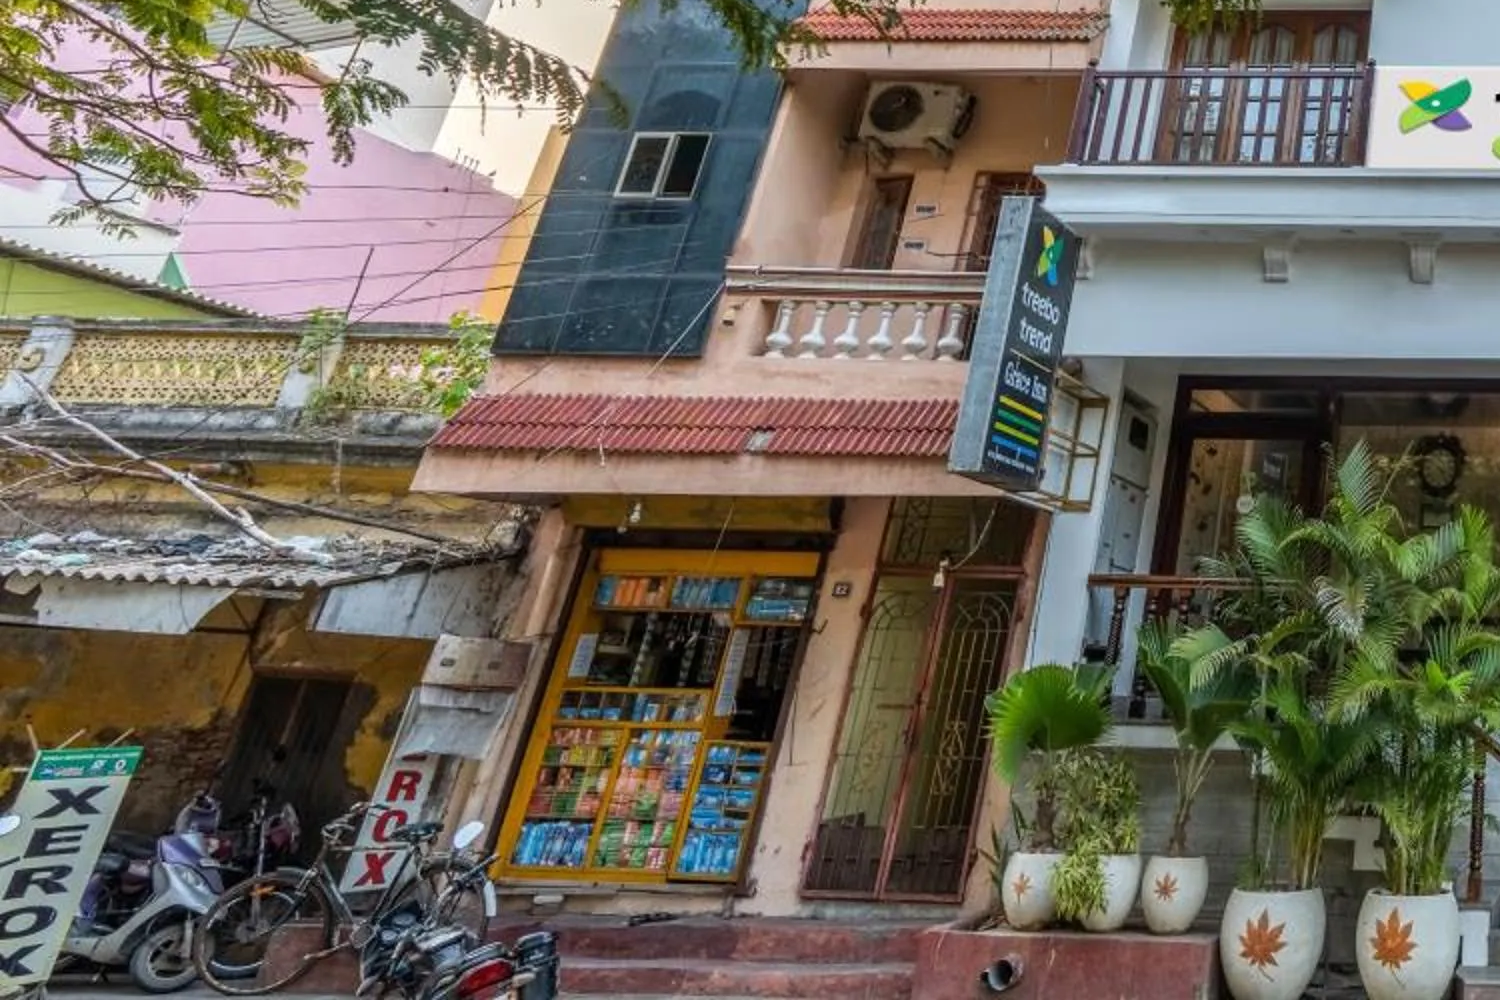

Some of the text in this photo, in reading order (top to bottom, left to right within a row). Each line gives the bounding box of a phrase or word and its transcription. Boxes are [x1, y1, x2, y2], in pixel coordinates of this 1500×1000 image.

[1022, 282, 1060, 325] treebo
[1020, 316, 1053, 353] trend
[1004, 361, 1032, 395] Grace
